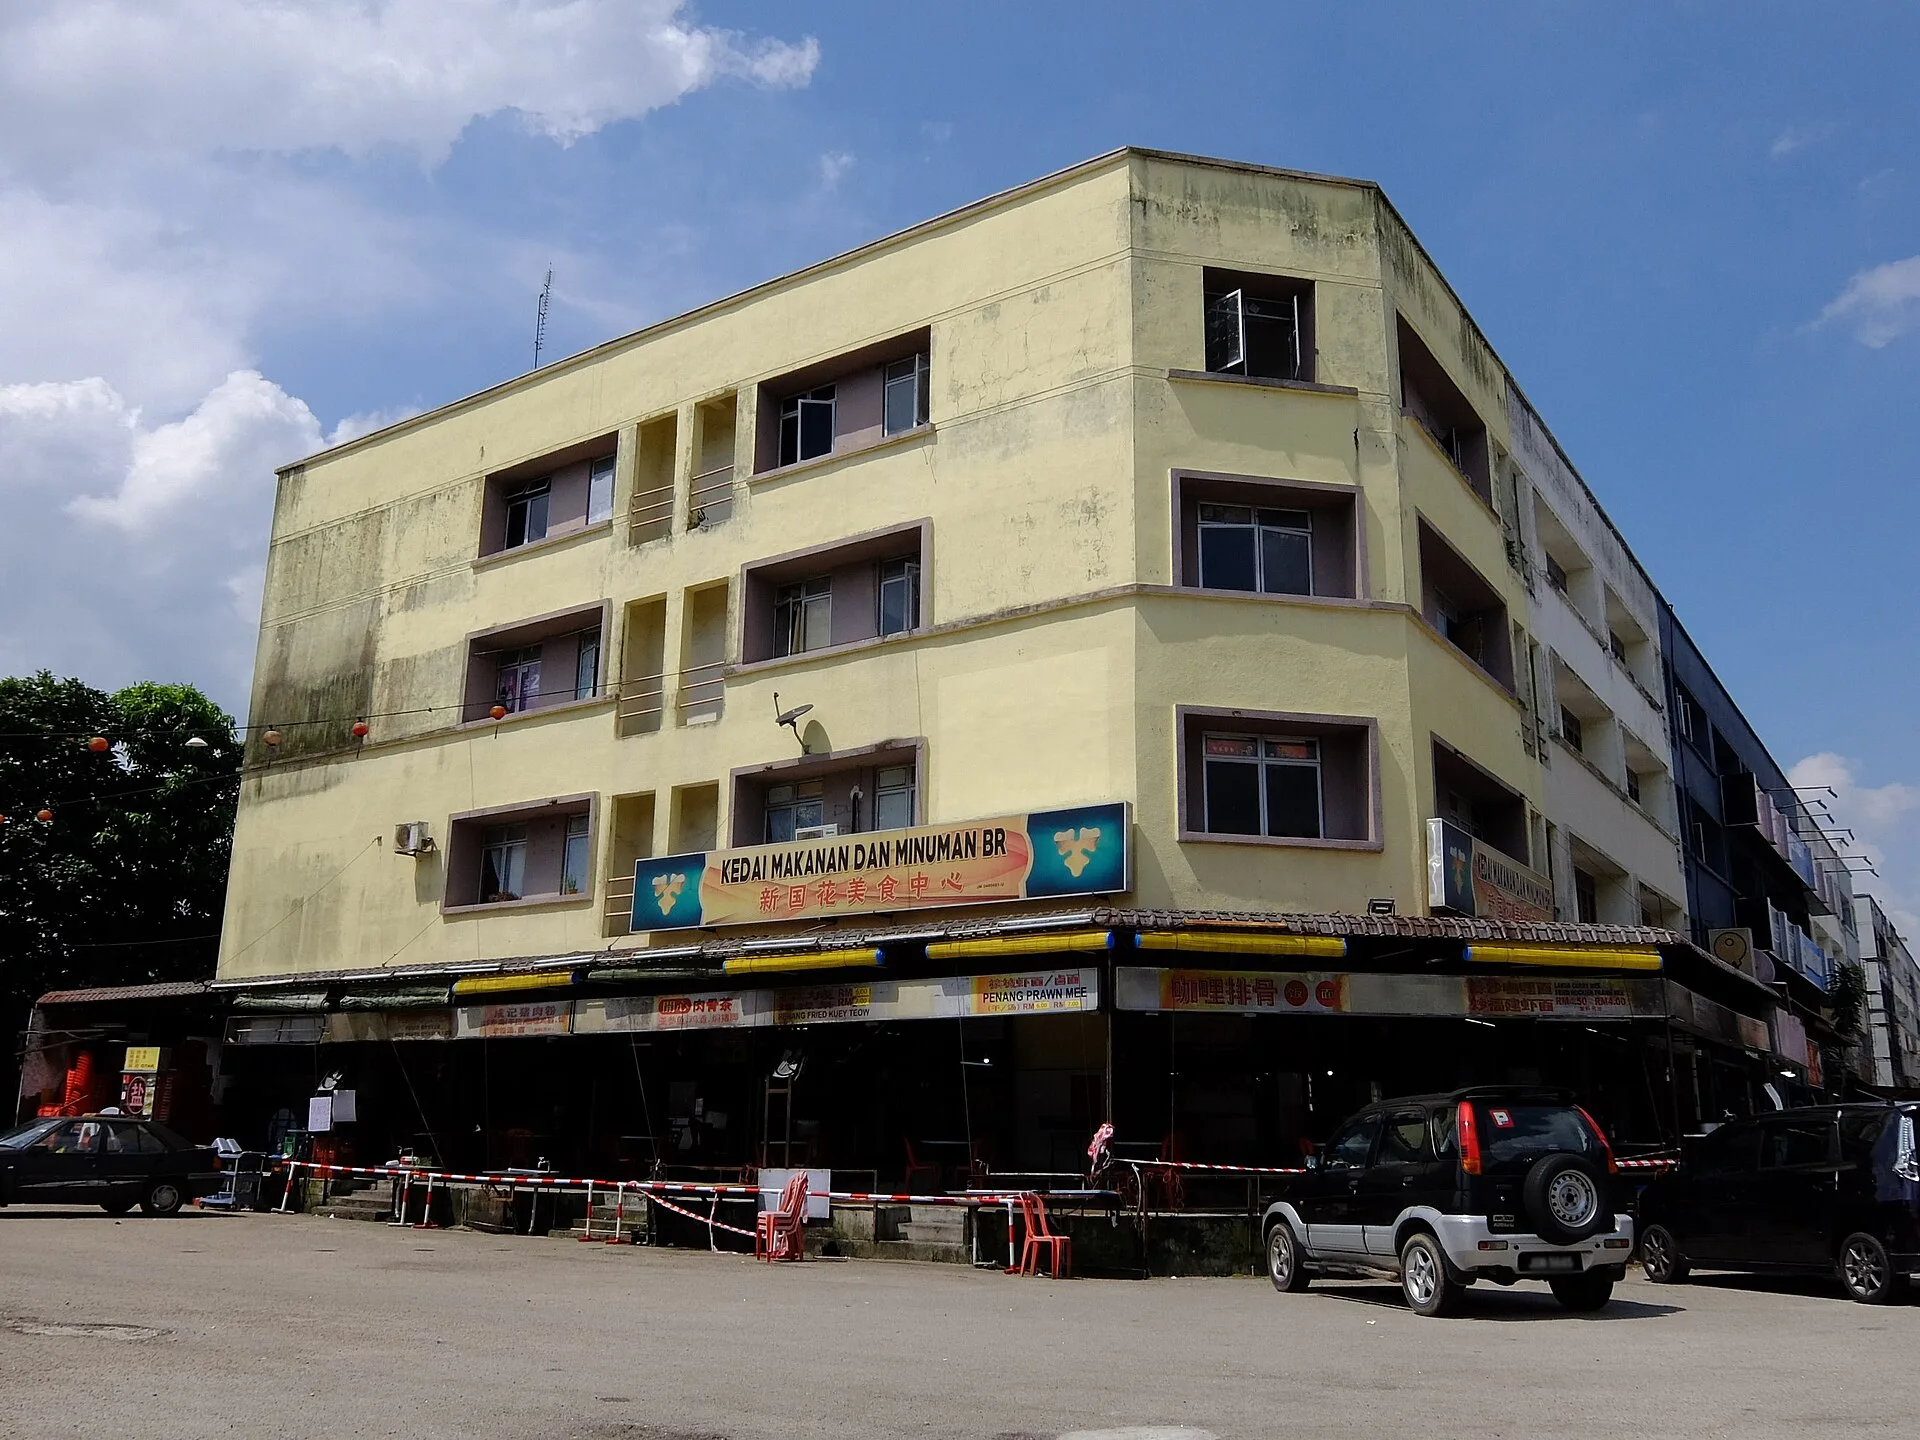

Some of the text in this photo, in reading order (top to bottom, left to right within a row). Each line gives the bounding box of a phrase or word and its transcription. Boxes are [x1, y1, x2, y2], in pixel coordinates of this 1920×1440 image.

[720, 827, 1007, 885] KEDAI MAKANAN DAN MINUMAN BR
[759, 871, 964, 913] 新国花美食中心
[983, 986, 1087, 1004] PENANG PRAWN MEE
[807, 1010, 828, 1019] FRIED
[828, 1009, 848, 1018] KUEY
[849, 1008, 870, 1017] TEOW
[1493, 1111, 1509, 1126] P
